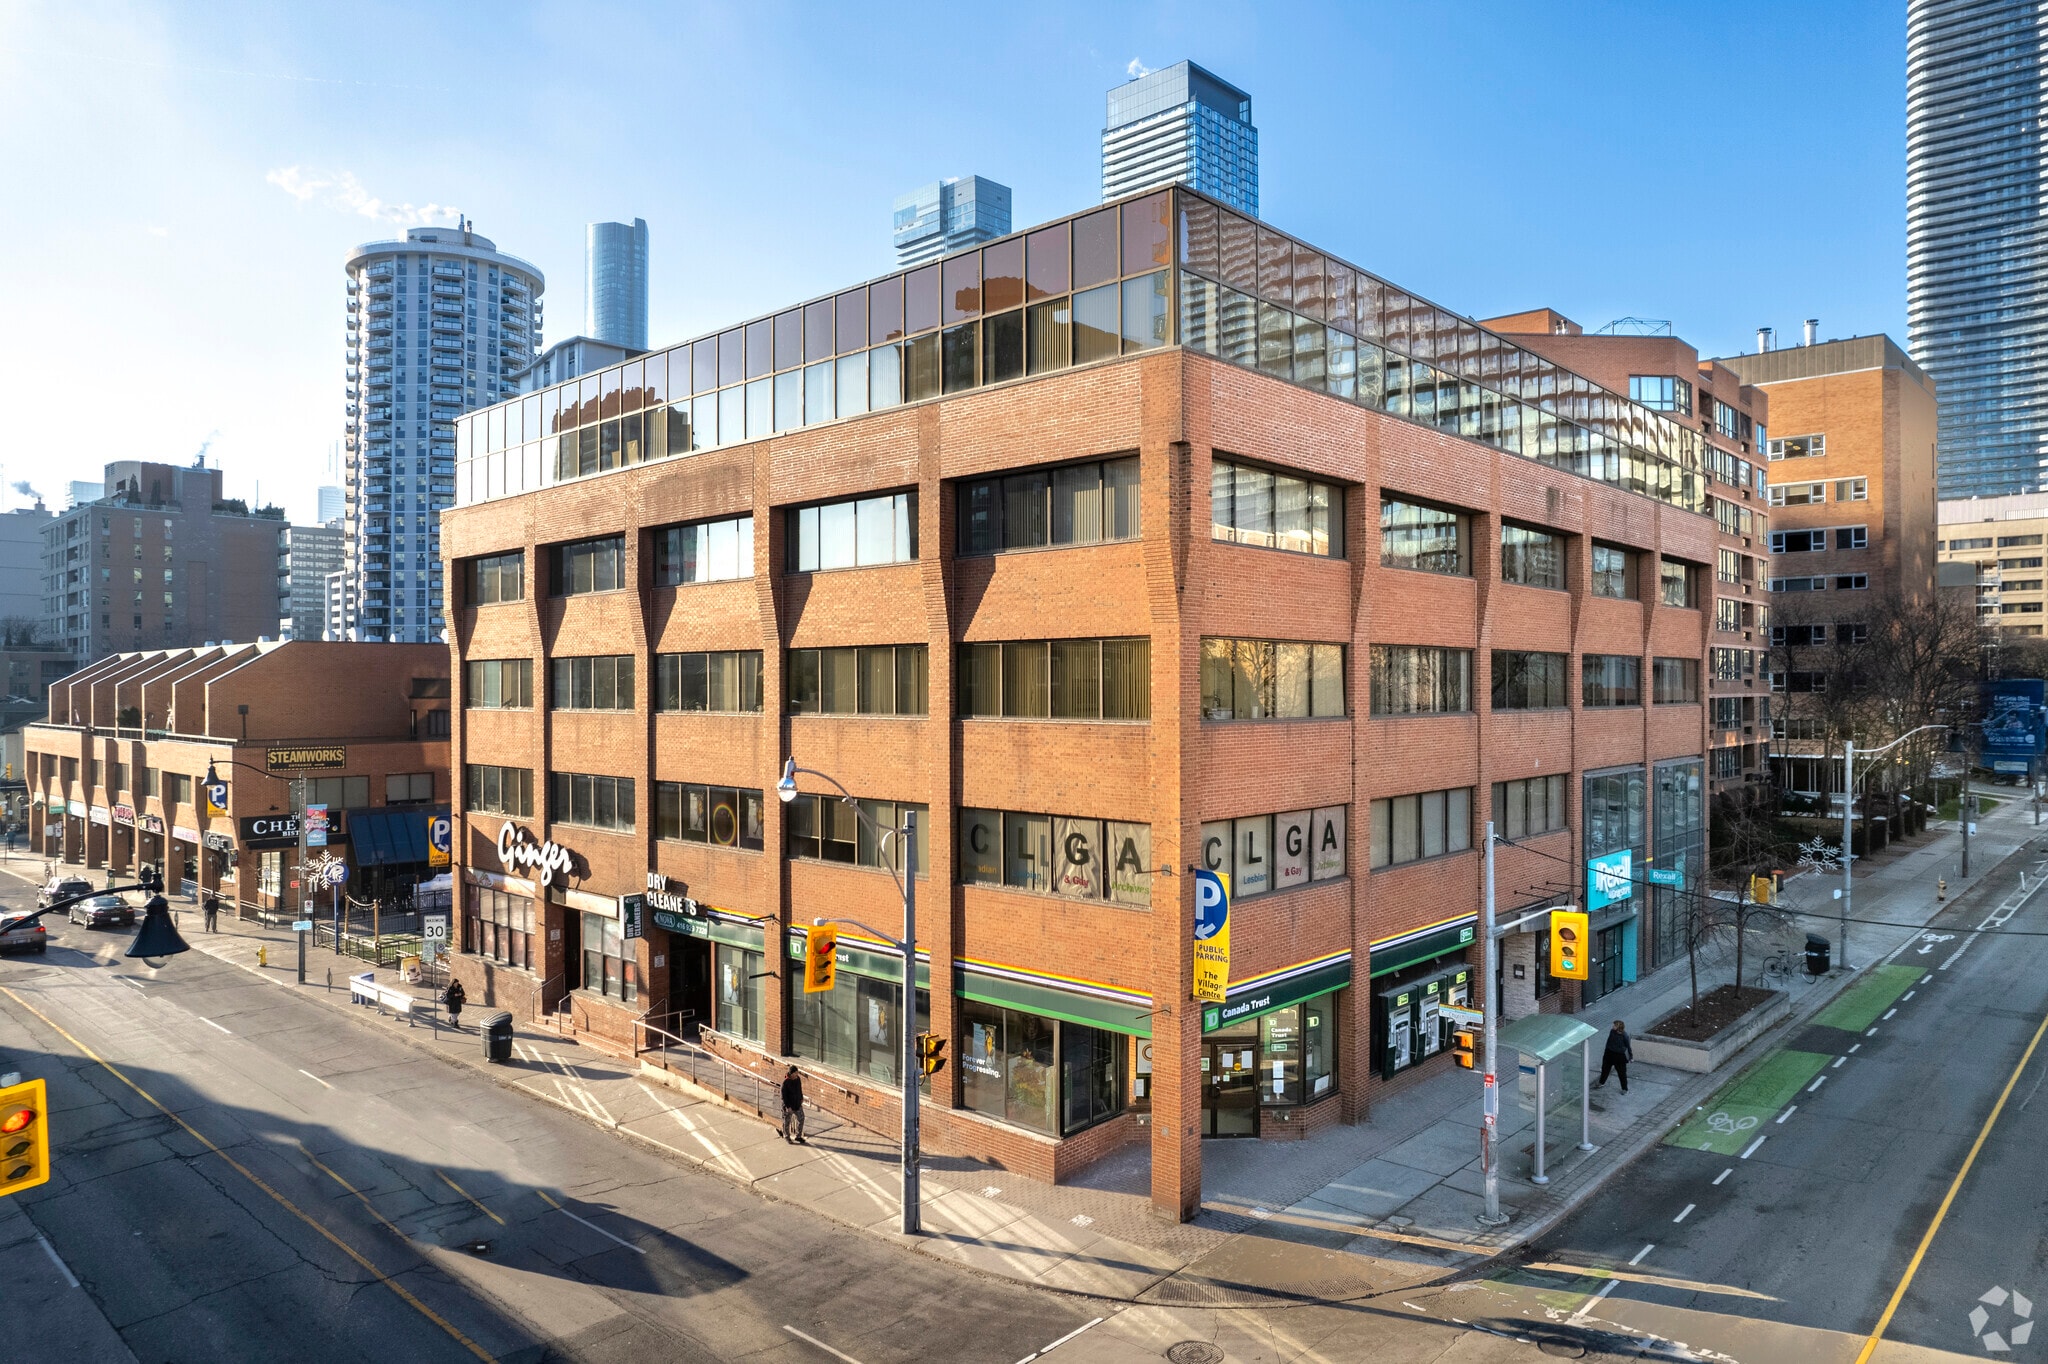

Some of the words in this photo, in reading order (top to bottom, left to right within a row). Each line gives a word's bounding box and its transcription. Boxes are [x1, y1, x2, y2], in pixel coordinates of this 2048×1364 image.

[269, 749, 343, 764] STEAMWORKS
[211, 785, 226, 801] P
[434, 820, 450, 843] P
[971, 824, 989, 854] C
[1018, 827, 1035, 860] L
[1064, 833, 1090, 865] G
[1116, 837, 1143, 873] A
[1205, 837, 1222, 871] C
[1248, 831, 1262, 864] L
[1286, 825, 1302, 857] G
[1321, 819, 1337, 851] A
[498, 821, 572, 886] Ginger
[1285, 868, 1290, 876] &
[1290, 866, 1302, 876] Gay
[1596, 854, 1631, 893] Rexall
[1653, 871, 1676, 880] Rexall
[647, 872, 667, 890] DRY
[1064, 874, 1072, 883] &
[1072, 876, 1089, 888] Gay
[1243, 873, 1267, 885] Lesbian
[1111, 881, 1150, 895] Archives
[1195, 878, 1221, 920] P
[633, 902, 642, 937] CLEANERS
[426, 926, 443, 937] 30
[626, 923, 634, 938] DRY
[792, 942, 801, 954] TD
[836, 953, 849, 962] rust
[1198, 944, 1224, 955] PUBLIC
[1196, 952, 1228, 963] PARKING
[1203, 971, 1218, 980] The
[1197, 979, 1223, 991] Village
[1198, 988, 1221, 999] Centre
[1205, 1011, 1217, 1027] TD
[1222, 1003, 1250, 1018] Canada
[1250, 996, 1270, 1009] Trust
[1307, 1016, 1319, 1027] TD
[962, 1053, 986, 1065] Forever
[962, 1061, 1001, 1079] Progressing.
